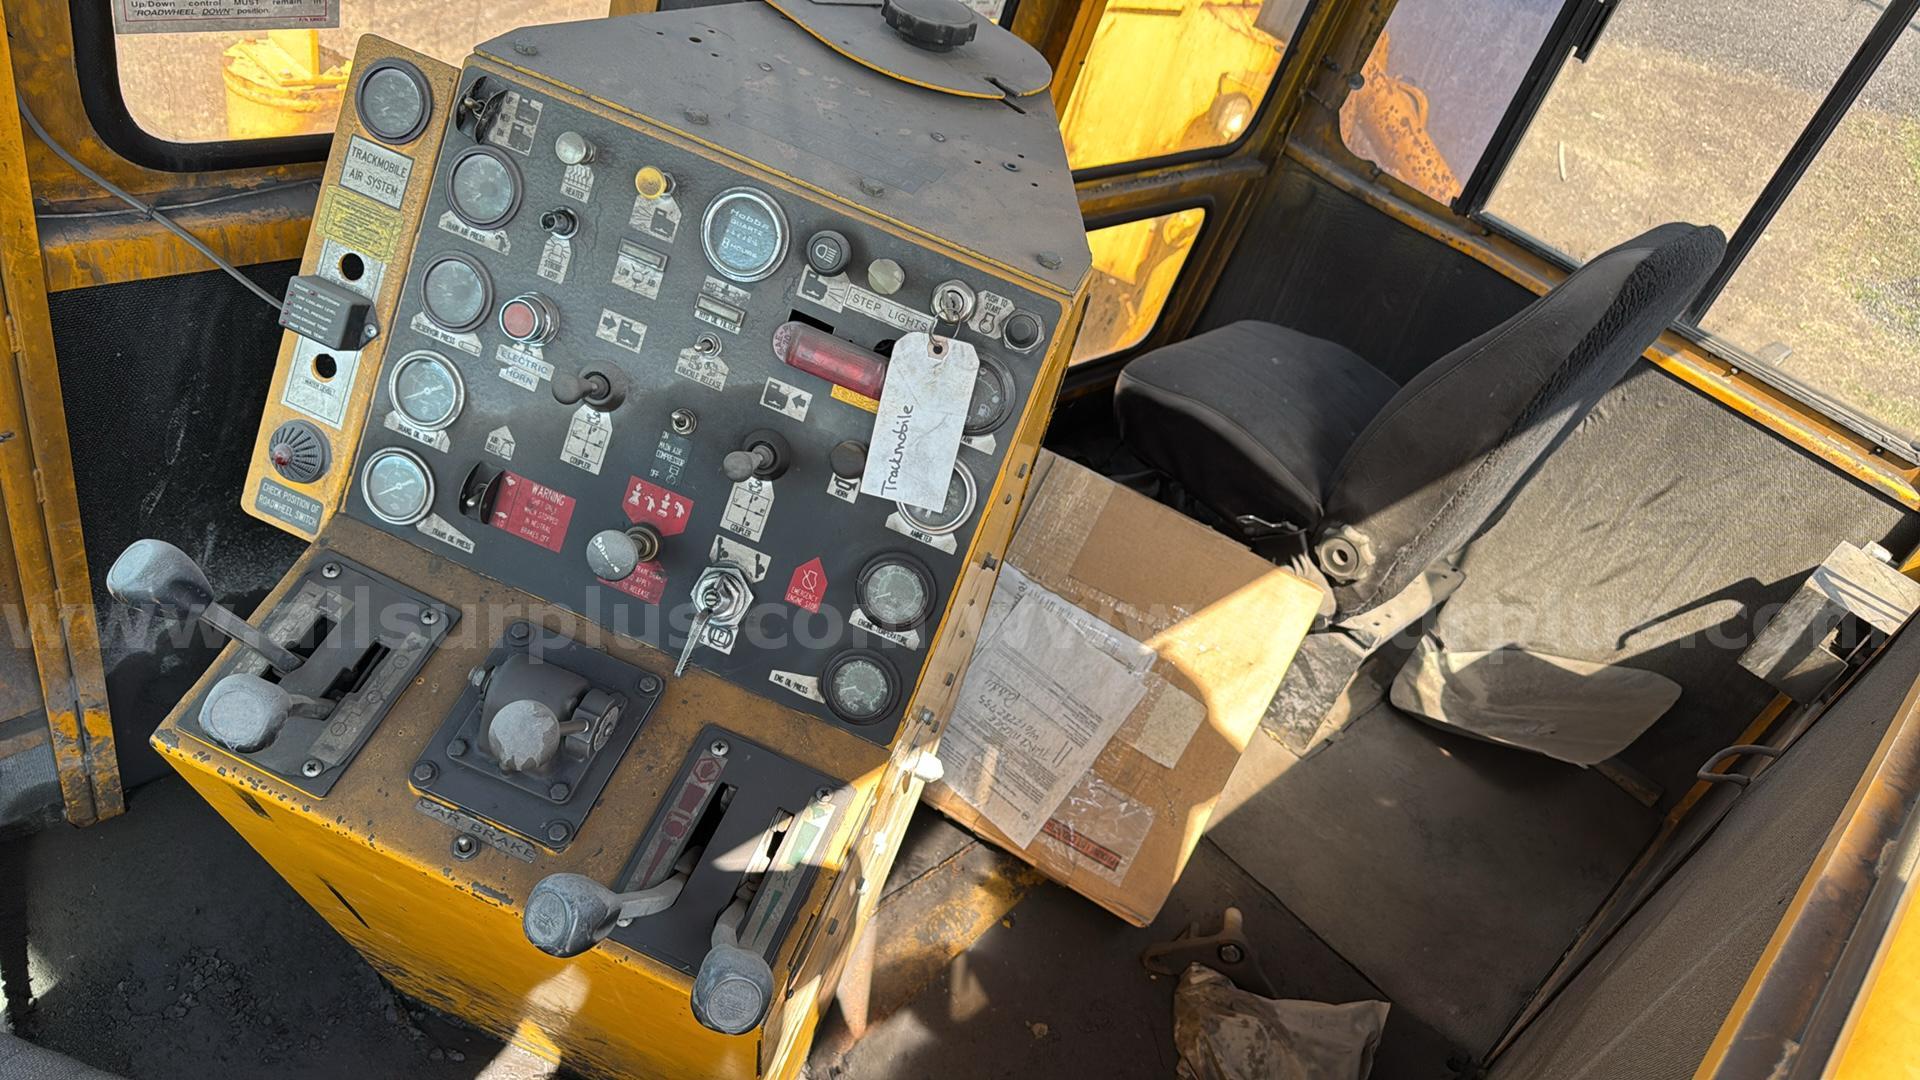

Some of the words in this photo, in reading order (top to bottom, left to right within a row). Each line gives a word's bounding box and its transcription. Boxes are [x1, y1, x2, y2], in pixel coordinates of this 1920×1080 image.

[350, 146, 407, 178] TRACKMOBILE
[348, 168, 364, 181] AIR
[365, 174, 399, 197] SYSTEM
[469, 231, 485, 242] PRESS
[730, 218, 763, 236] QUARTZ
[984, 292, 999, 304] PUSH
[1000, 298, 1008, 308] TO
[984, 302, 1001, 315] START
[851, 293, 881, 312] STEP
[887, 309, 928, 332] LIGHTS
[439, 332, 455, 344] PRESS
[500, 350, 547, 374] ELECTRIC
[505, 368, 533, 385] HORN
[677, 365, 700, 380] KNUCKLE
[700, 375, 721, 389] RELEASE
[880, 401, 913, 498] Trackmobile
[569, 455, 591, 470] COUPLER
[262, 482, 283, 497] CHECK
[282, 491, 310, 509] POSITION
[309, 504, 319, 513] OF
[530, 483, 566, 506] WARNING
[834, 487, 848, 498] HORN
[258, 494, 294, 516] ROADWHEEL
[294, 510, 317, 527] SWITCH
[431, 527, 447, 539] TRANS
[455, 538, 471, 550] PRESS
[730, 523, 751, 537] COUPLER
[628, 585, 650, 598] RELEASE
[790, 586, 817, 602] EMERGENCY
[787, 593, 802, 605] ENGINE
[804, 600, 817, 611] STOP
[773, 673, 783, 683] ENG
[792, 681, 809, 694] PRESS
[419, 798, 459, 822] CAR
[470, 823, 535, 859] BRAKE
